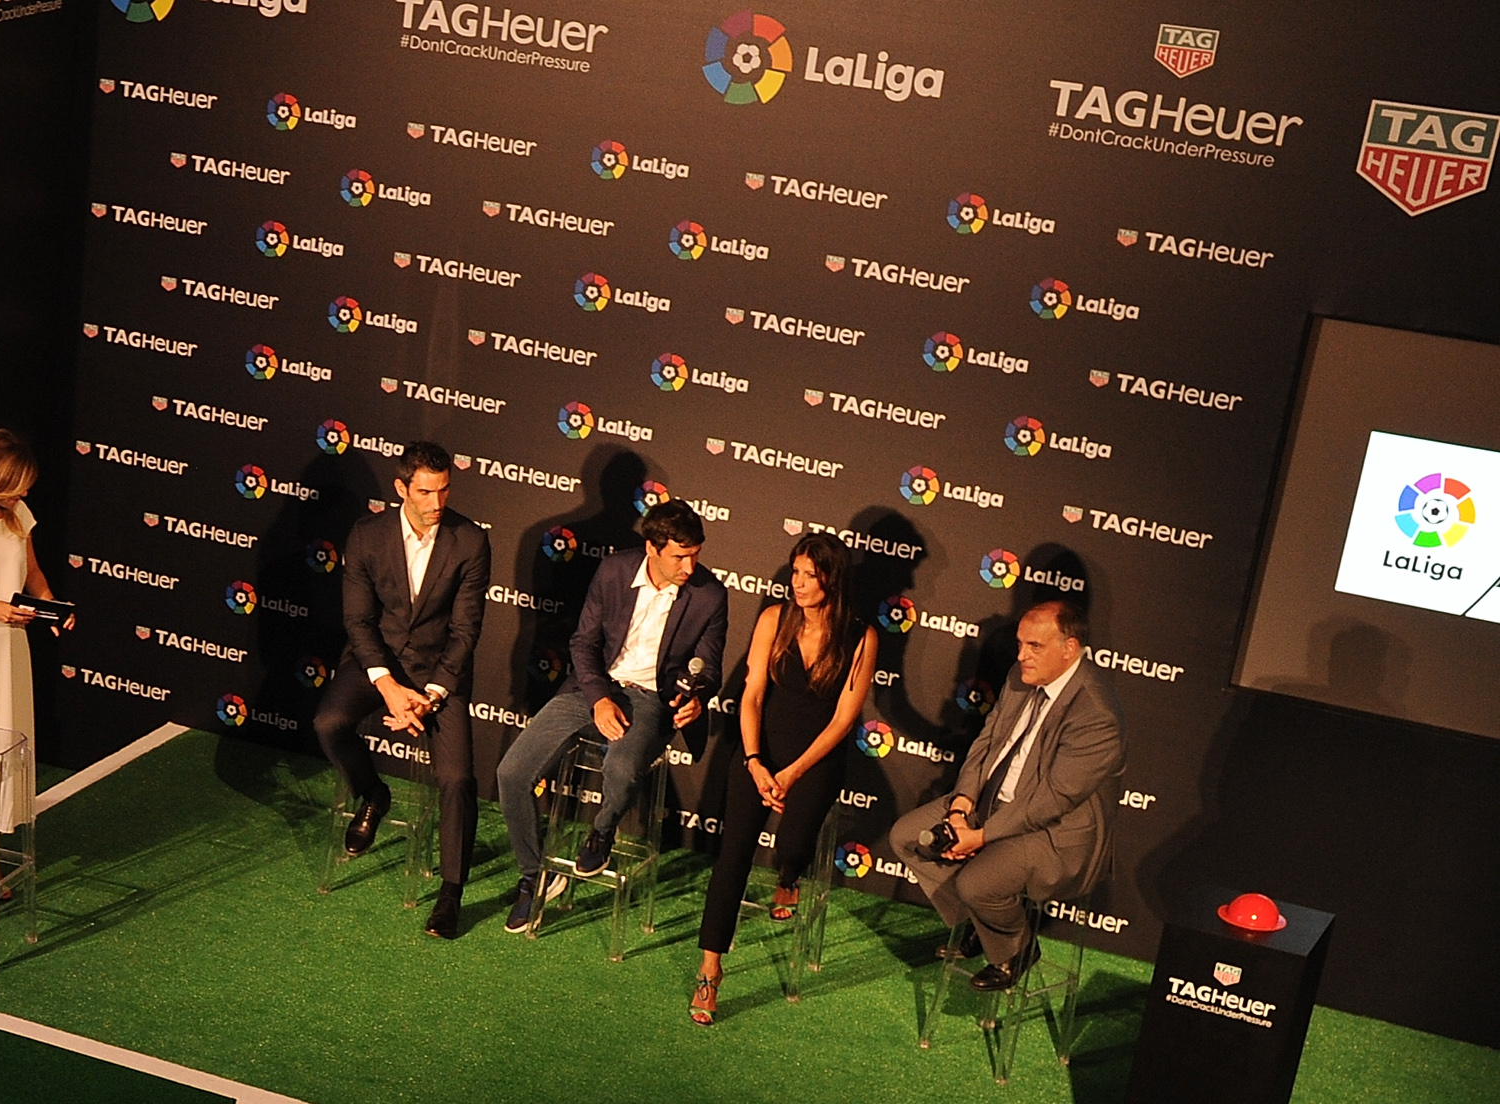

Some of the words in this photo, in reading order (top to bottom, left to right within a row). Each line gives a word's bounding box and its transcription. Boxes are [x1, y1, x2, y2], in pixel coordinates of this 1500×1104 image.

[1165, 27, 1213, 49] TAG
[400, 35, 590, 72] #DontCrackUnderPressure
[1157, 46, 1211, 74] HEUER
[805, 47, 944, 101] LaLiga
[120, 81, 217, 109] TAGHeuer
[305, 108, 356, 129] LaLiga
[1049, 80, 1303, 146] TAGHeuer
[431, 126, 537, 156] TAGHeuer
[1048, 123, 1275, 168] #DontCrackUnderPressure
[1381, 108, 1487, 154] TAG
[192, 155, 290, 184] TAGHeuer
[632, 156, 689, 179] LaLiga
[1364, 146, 1483, 206] HEUER
[379, 184, 430, 206] LaLiga
[771, 176, 887, 209] TAGHeuer
[112, 206, 207, 234] TAGHeuer
[506, 204, 614, 236] TAGHeuer
[993, 209, 1055, 234] LaLiga
[293, 235, 343, 257] LaLiga
[711, 237, 768, 260] LaLiga
[1146, 232, 1273, 267] TAGHeuer
[417, 255, 521, 287] TAGHeuer
[852, 259, 970, 293] TAGHeuer
[182, 279, 279, 309] TAGHeuer
[615, 289, 670, 312] LaLiga
[1076, 295, 1139, 320] LaLiga
[366, 311, 417, 333] LaLiga
[751, 311, 865, 345] TAGHeuer
[104, 326, 197, 356] TAGHeuer
[491, 333, 597, 366] TAGHeuer
[282, 359, 331, 381] LaLiga
[967, 348, 1028, 373] LaLiga
[692, 369, 748, 393] LaLiga
[1117, 374, 1242, 410] TAGHeuer
[403, 381, 506, 413] TAGHeuer
[830, 393, 945, 429] TAGHeuer
[173, 400, 268, 430] TAGHeuer
[598, 417, 652, 441] LaLiga
[96, 444, 188, 475] TAGHeuer
[353, 434, 404, 457] LaLiga
[731, 442, 843, 477] TAGHeuer
[1050, 433, 1111, 458] LaLiga
[271, 478, 319, 501] LaLiga
[477, 458, 581, 492] TAGHeuer
[675, 496, 730, 521] Liga
[944, 482, 1003, 507] LaLiga
[164, 516, 257, 548] TAGHeuer
[1090, 510, 1212, 548] TAGHeuer
[88, 558, 179, 589] TAGHeuer
[1024, 565, 1084, 592] LaLiga
[1384, 551, 1463, 581] LaLiga
[262, 595, 308, 618] LaLiga
[485, 585, 564, 613] GHeuer
[920, 612, 979, 637] LaLiga
[156, 630, 247, 662] TAGHeuer
[81, 669, 170, 701] TAGHeuer
[251, 708, 297, 731] LaLiga
[898, 737, 954, 761] LaLiga
[876, 858, 919, 883] LaLig
[1168, 976, 1276, 1017] TAGHeuer
